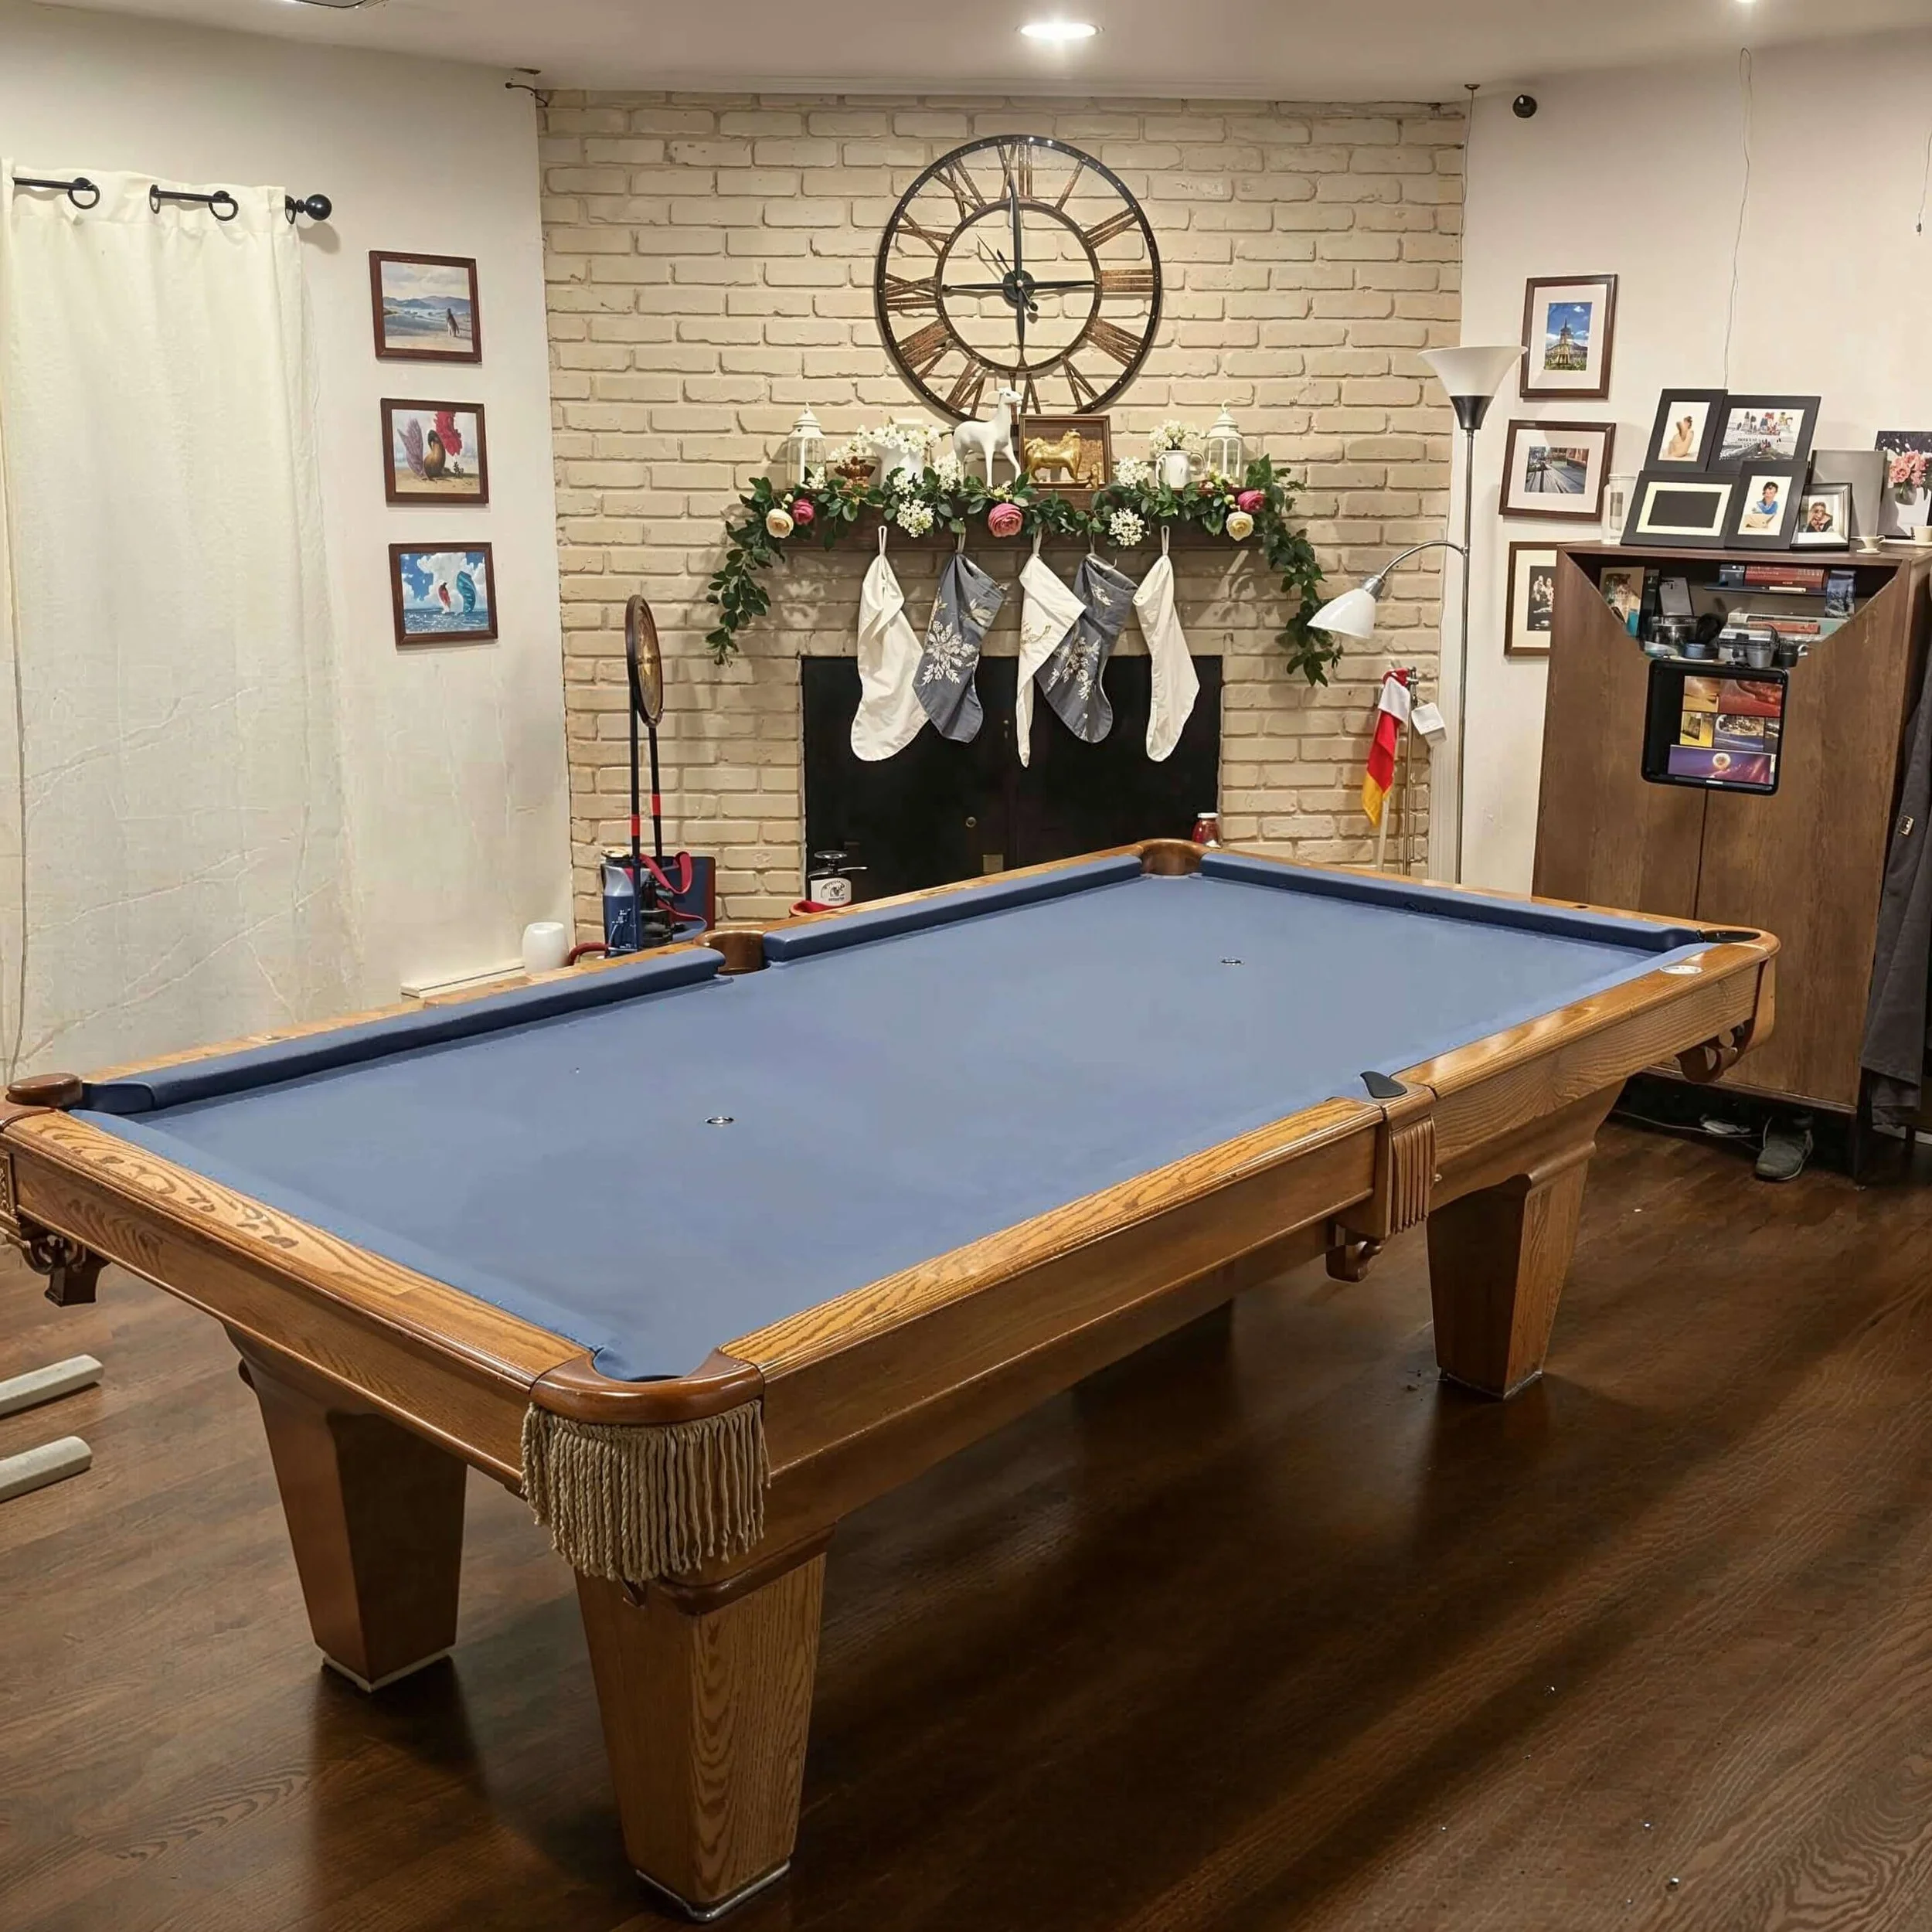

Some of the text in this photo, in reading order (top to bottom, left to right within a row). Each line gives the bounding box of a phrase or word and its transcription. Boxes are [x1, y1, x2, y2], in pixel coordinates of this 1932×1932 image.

[932, 158, 987, 222] XI
[997, 141, 1033, 199] XII
[1054, 160, 1084, 211] I
[895, 212, 951, 257] X
[1083, 206, 1138, 249] II
[1100, 269, 1154, 292] III
[1061, 356, 1100, 410] V
